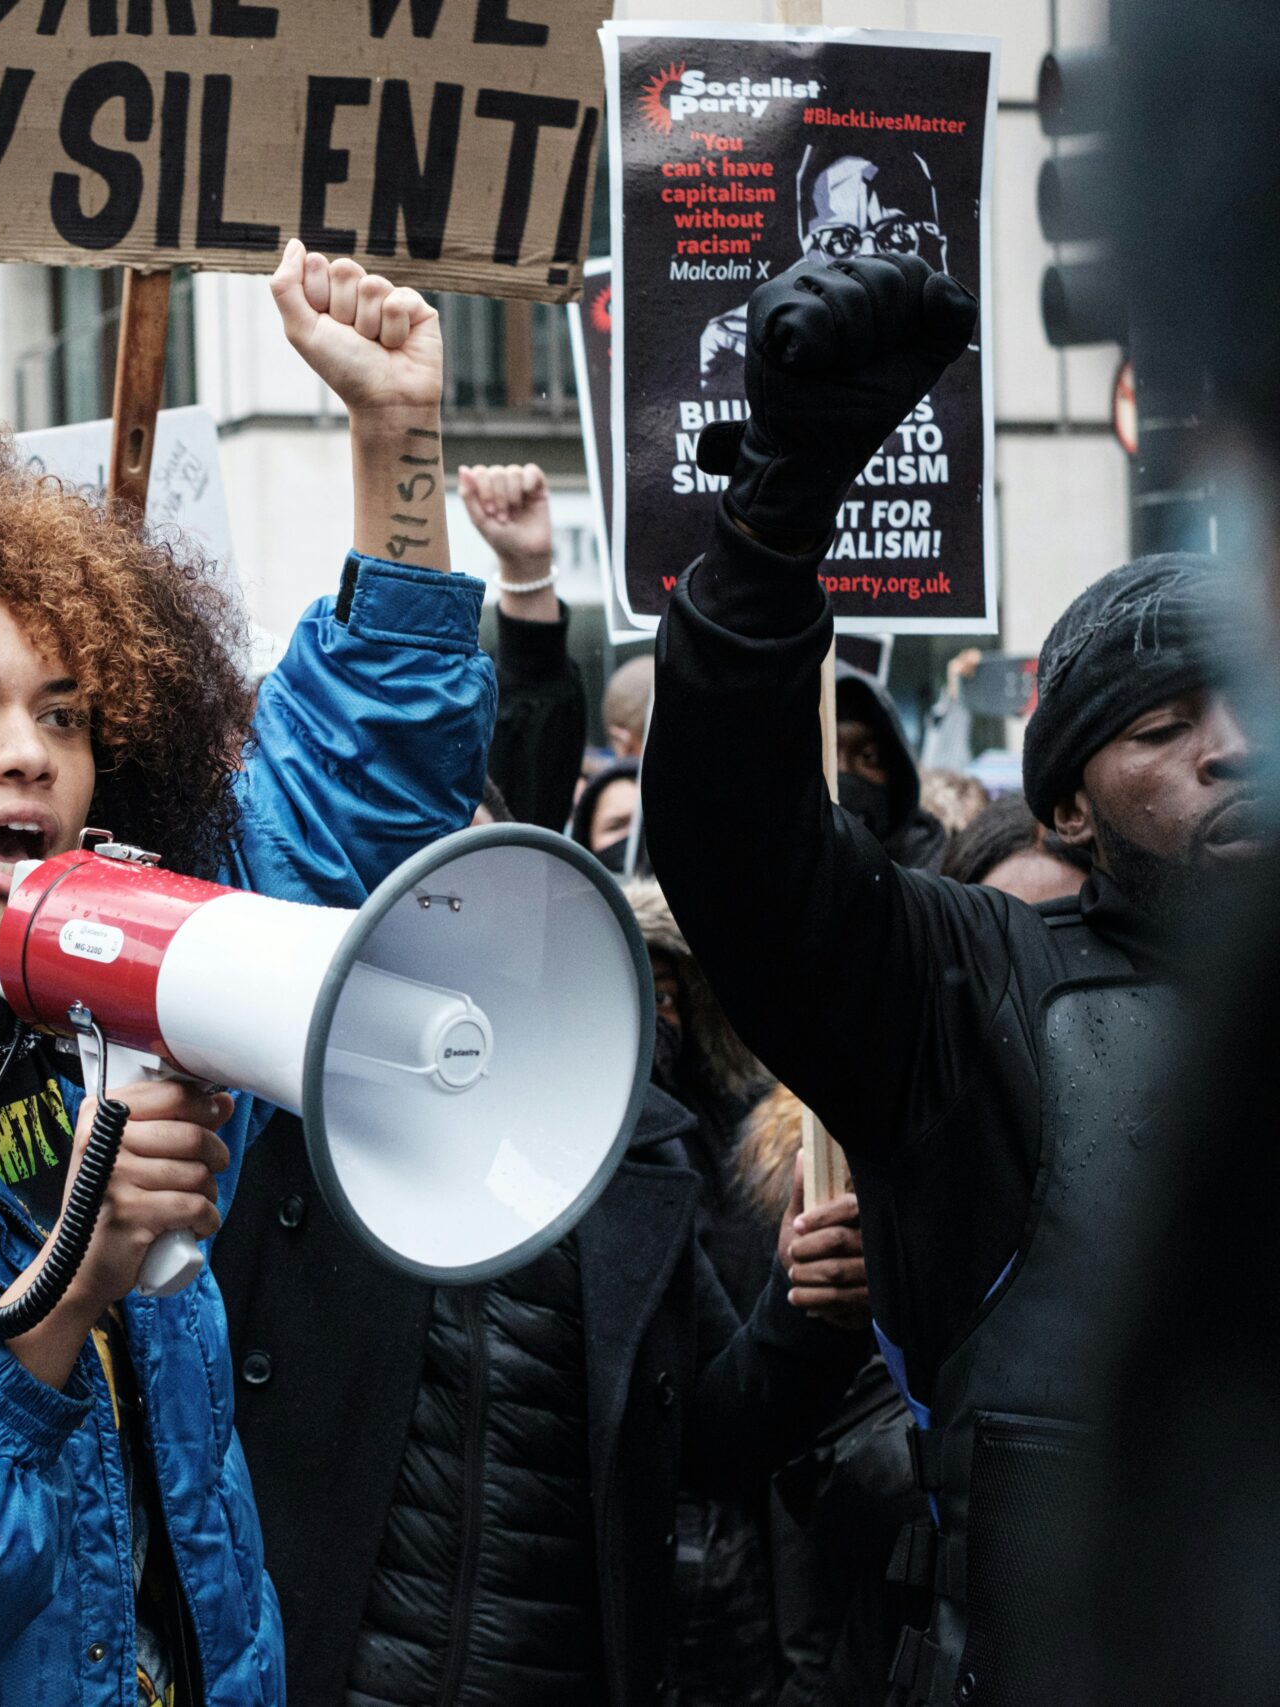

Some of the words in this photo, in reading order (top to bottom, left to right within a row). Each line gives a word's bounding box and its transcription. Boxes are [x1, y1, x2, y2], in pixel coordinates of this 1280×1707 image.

[680, 69, 821, 99] Socialist
[802, 108, 967, 134] #BlackLivesMatter
[50, 60, 599, 285] SILENT!
[661, 156, 717, 177] can't
[722, 156, 774, 177] have
[661, 182, 776, 208] capitalism
[674, 208, 765, 228] without
[670, 259, 751, 281] Malcolm
[756, 260, 771, 280] X
[895, 423, 944, 454] TO
[855, 454, 950, 486] CISM
[871, 499, 932, 529] FOR
[452, 1049, 480, 1057] adastra
